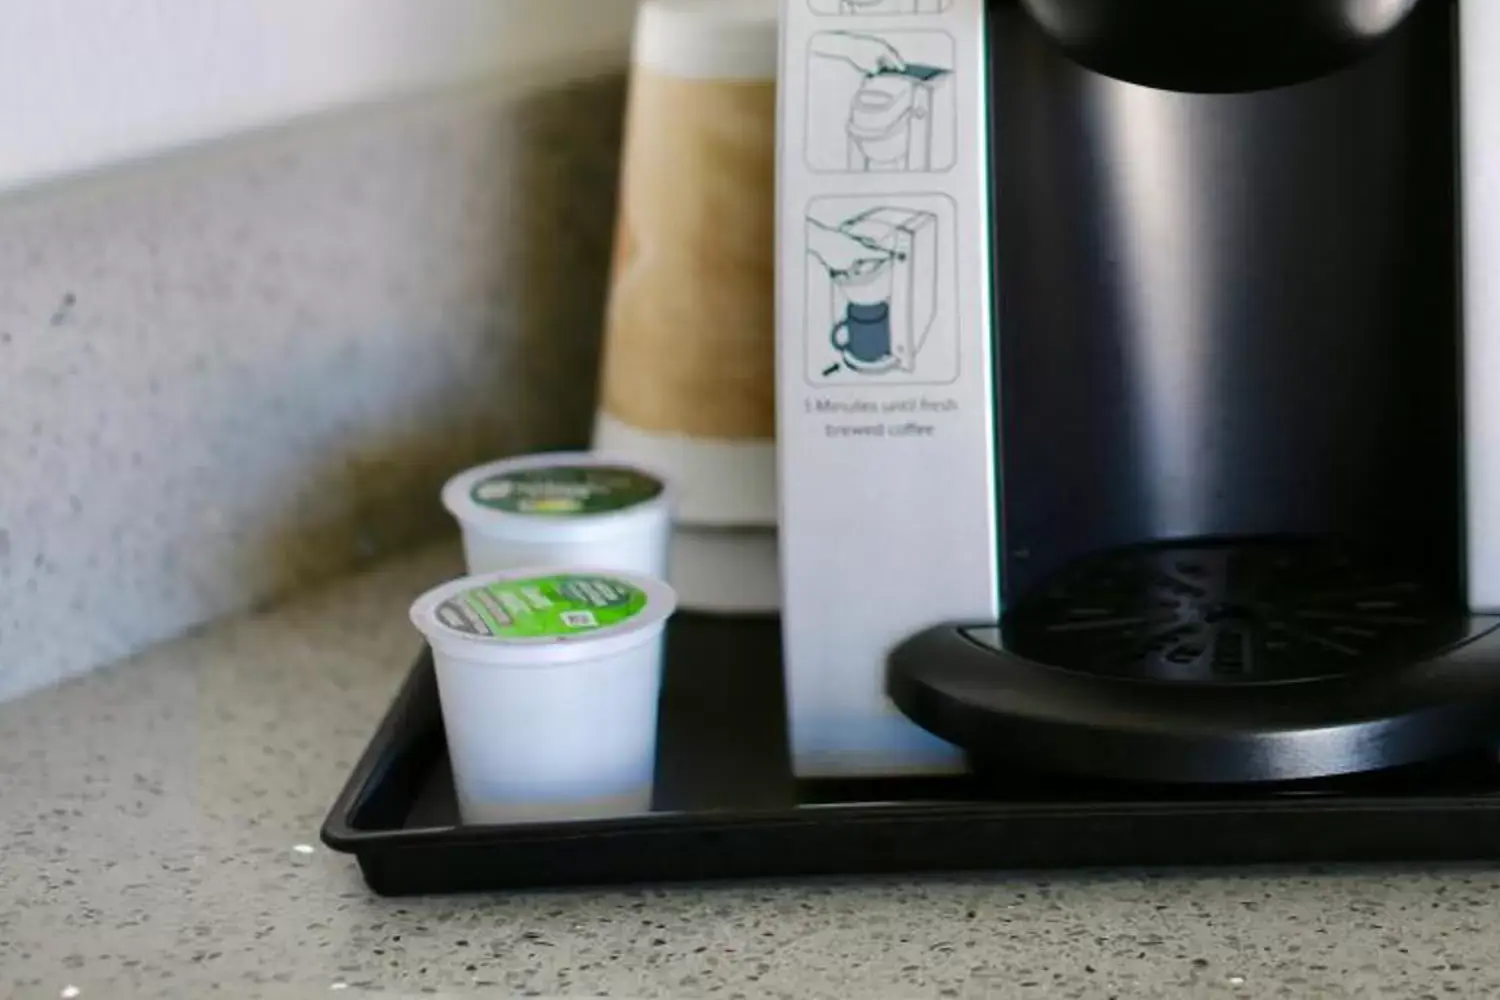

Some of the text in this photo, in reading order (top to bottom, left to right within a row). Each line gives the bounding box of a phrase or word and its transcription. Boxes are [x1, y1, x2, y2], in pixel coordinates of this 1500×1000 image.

[815, 396, 877, 413] Minutes
[825, 420, 934, 438] brewed coffee
